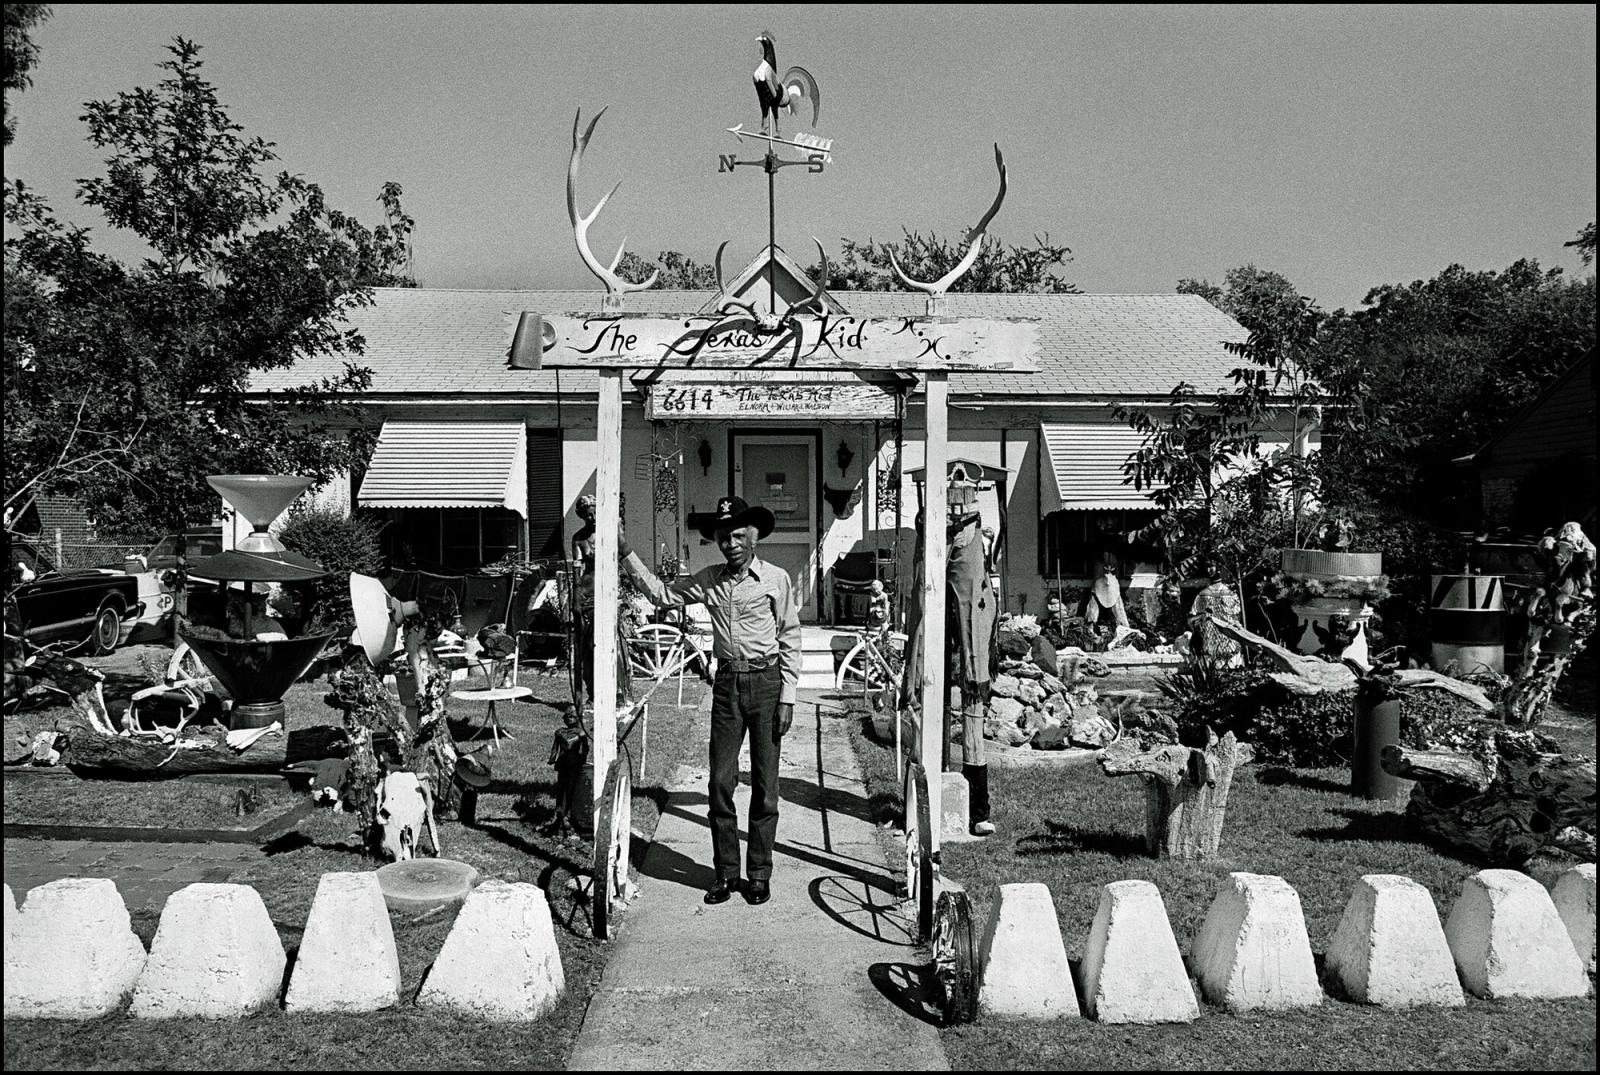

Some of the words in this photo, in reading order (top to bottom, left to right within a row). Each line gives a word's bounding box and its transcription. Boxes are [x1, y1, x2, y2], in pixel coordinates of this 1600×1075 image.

[718, 154, 737, 173] N
[808, 154, 824, 173] S
[565, 316, 638, 357] The
[657, 317, 769, 356] Texas
[801, 316, 868, 361] Kid
[663, 388, 713, 411] 6614
